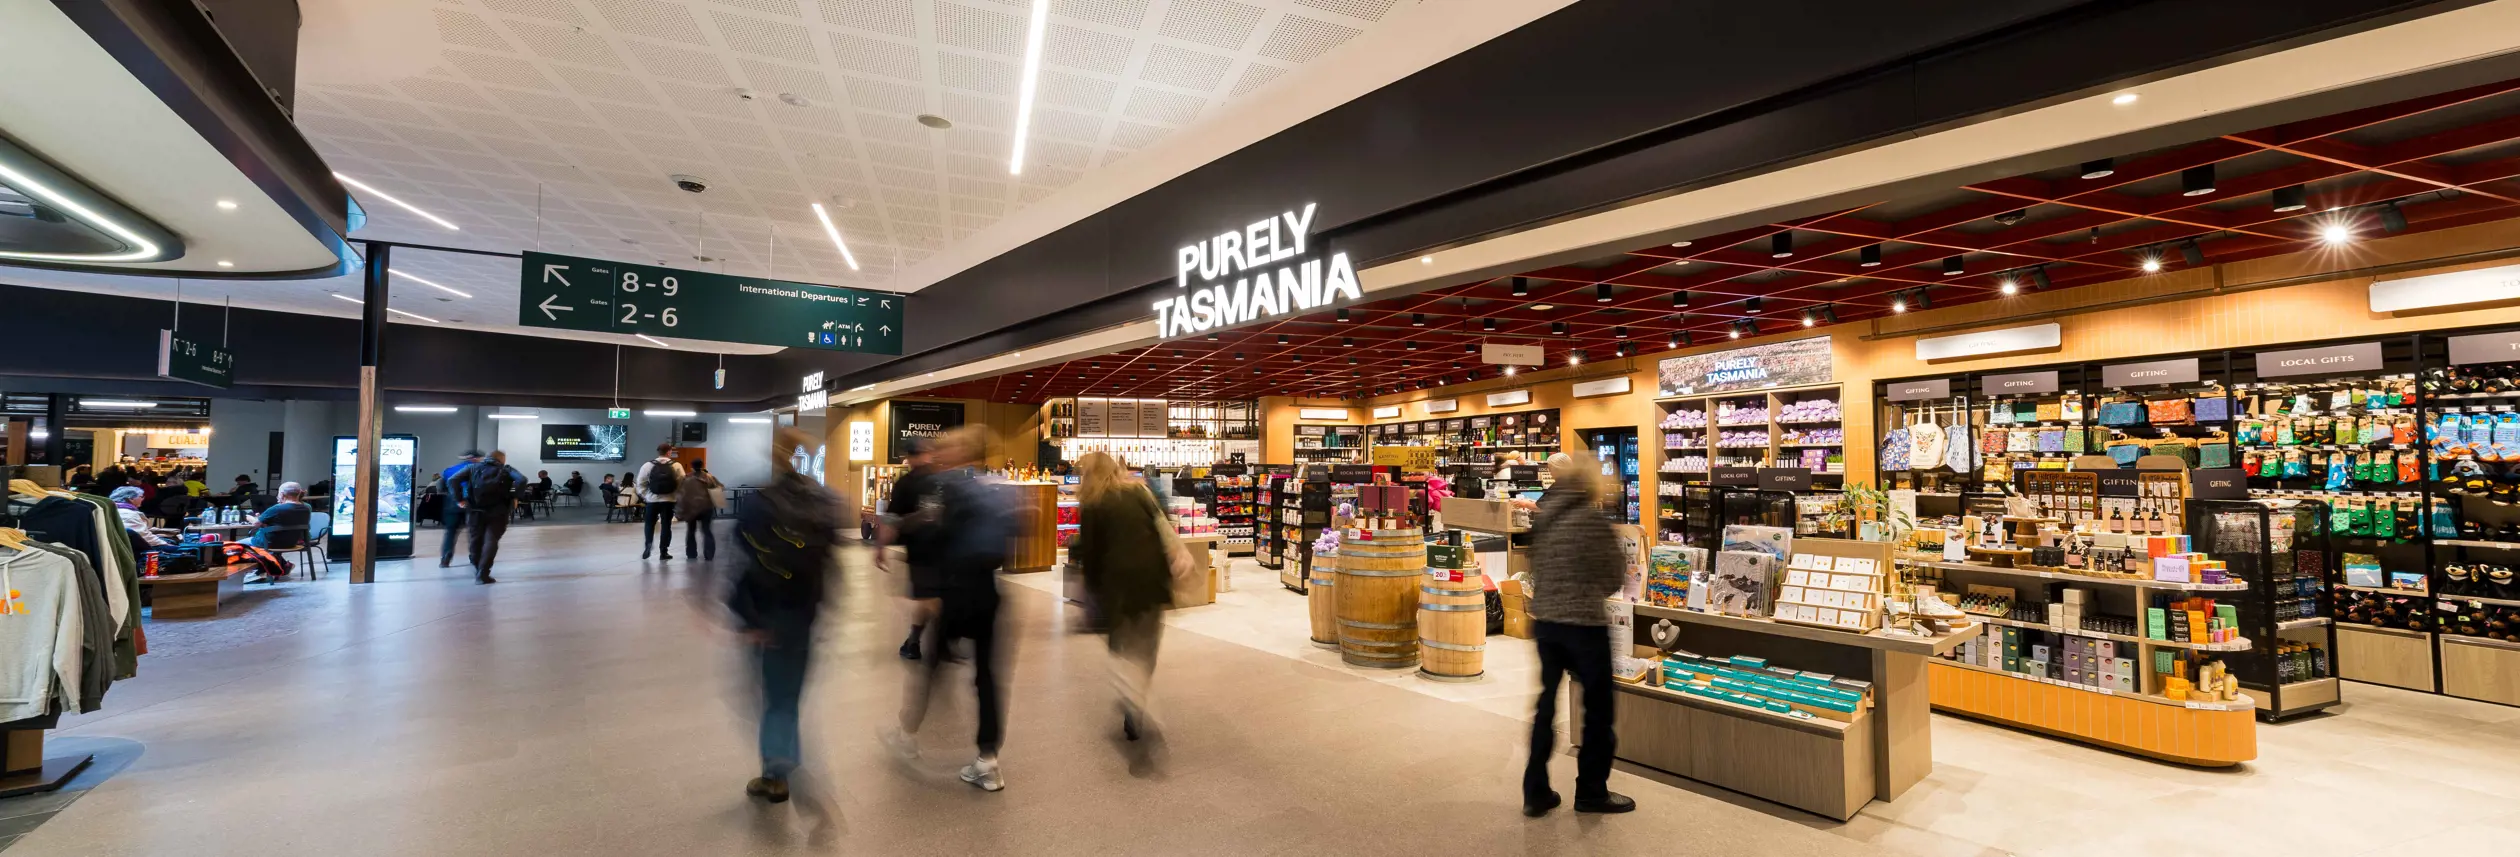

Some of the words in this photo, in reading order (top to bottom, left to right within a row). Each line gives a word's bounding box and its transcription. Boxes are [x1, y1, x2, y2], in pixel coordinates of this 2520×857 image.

[1178, 202, 1317, 288] PURELY
[739, 283, 799, 298] International
[801, 291, 849, 304] Departures
[1152, 252, 1362, 340] TASMANIA
[590, 298, 608, 306] Gates
[1714, 357, 1758, 372] PURELY
[2280, 358, 2317, 367] LOCAL
[2320, 355, 2355, 364] GIFTS
[1706, 368, 1769, 384] TASMANIA
[2130, 369, 2168, 378] GIFTING
[802, 370, 824, 393] PURELY
[2004, 380, 2034, 388] GIFTING
[1905, 387, 1930, 395] GIFTING
[908, 423, 941, 431] PURELY
[901, 430, 949, 438] TASMANIA
[2102, 478, 2138, 486] GIFTIN
[2209, 480, 2232, 488] GIFTING
